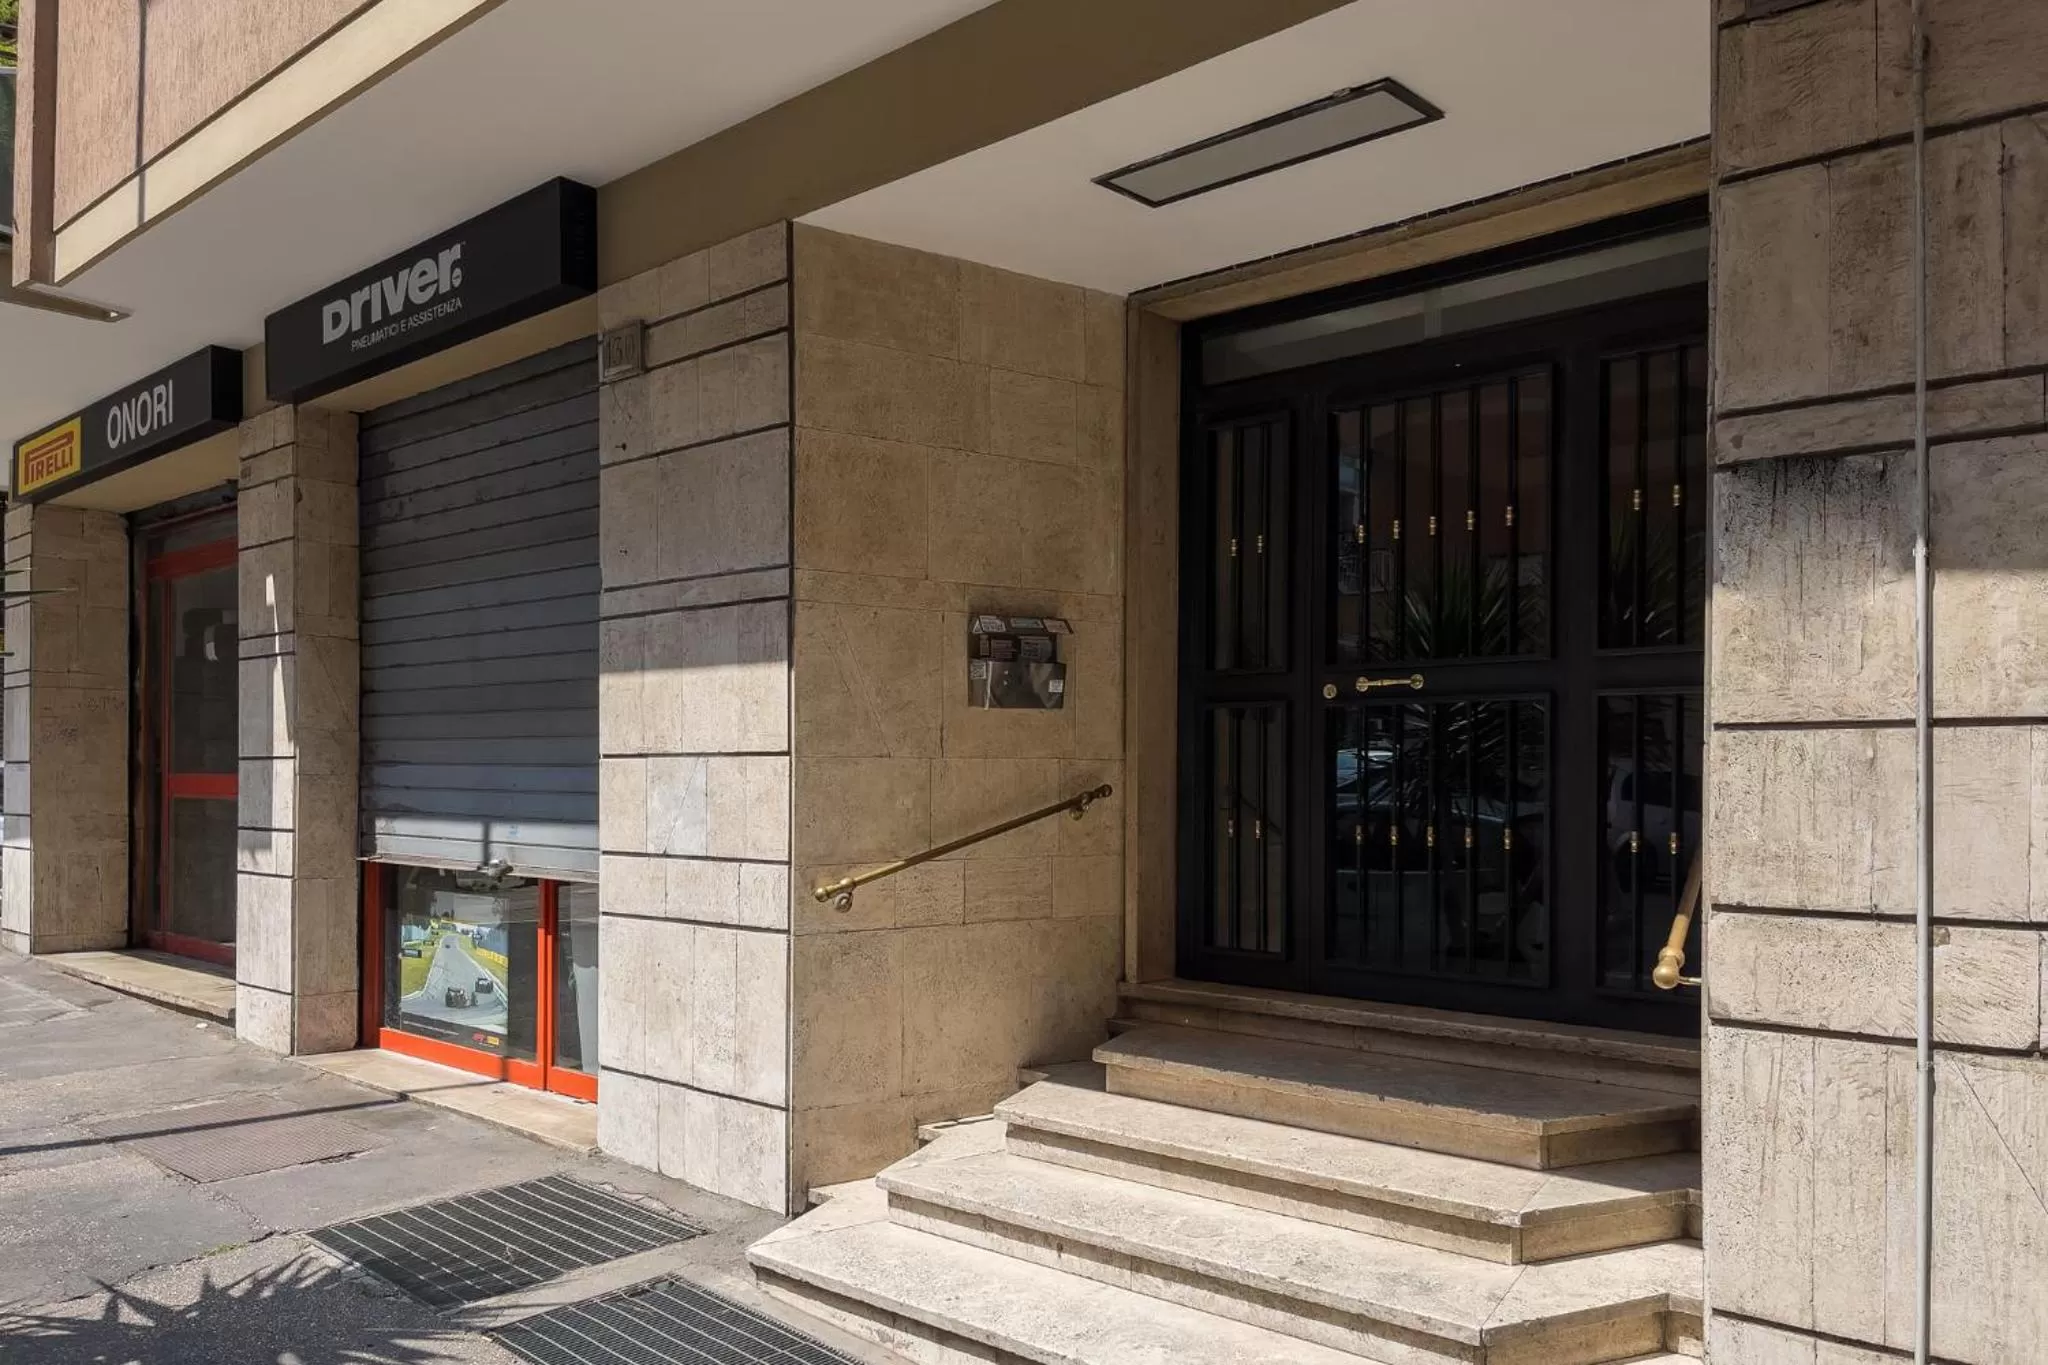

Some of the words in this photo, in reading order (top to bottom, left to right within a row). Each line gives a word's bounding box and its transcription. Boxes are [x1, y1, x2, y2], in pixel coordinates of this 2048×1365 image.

[407, 297, 463, 328] ASSISTENZA
[107, 379, 174, 449] ONORI
[24, 430, 75, 485] PIRELLI
